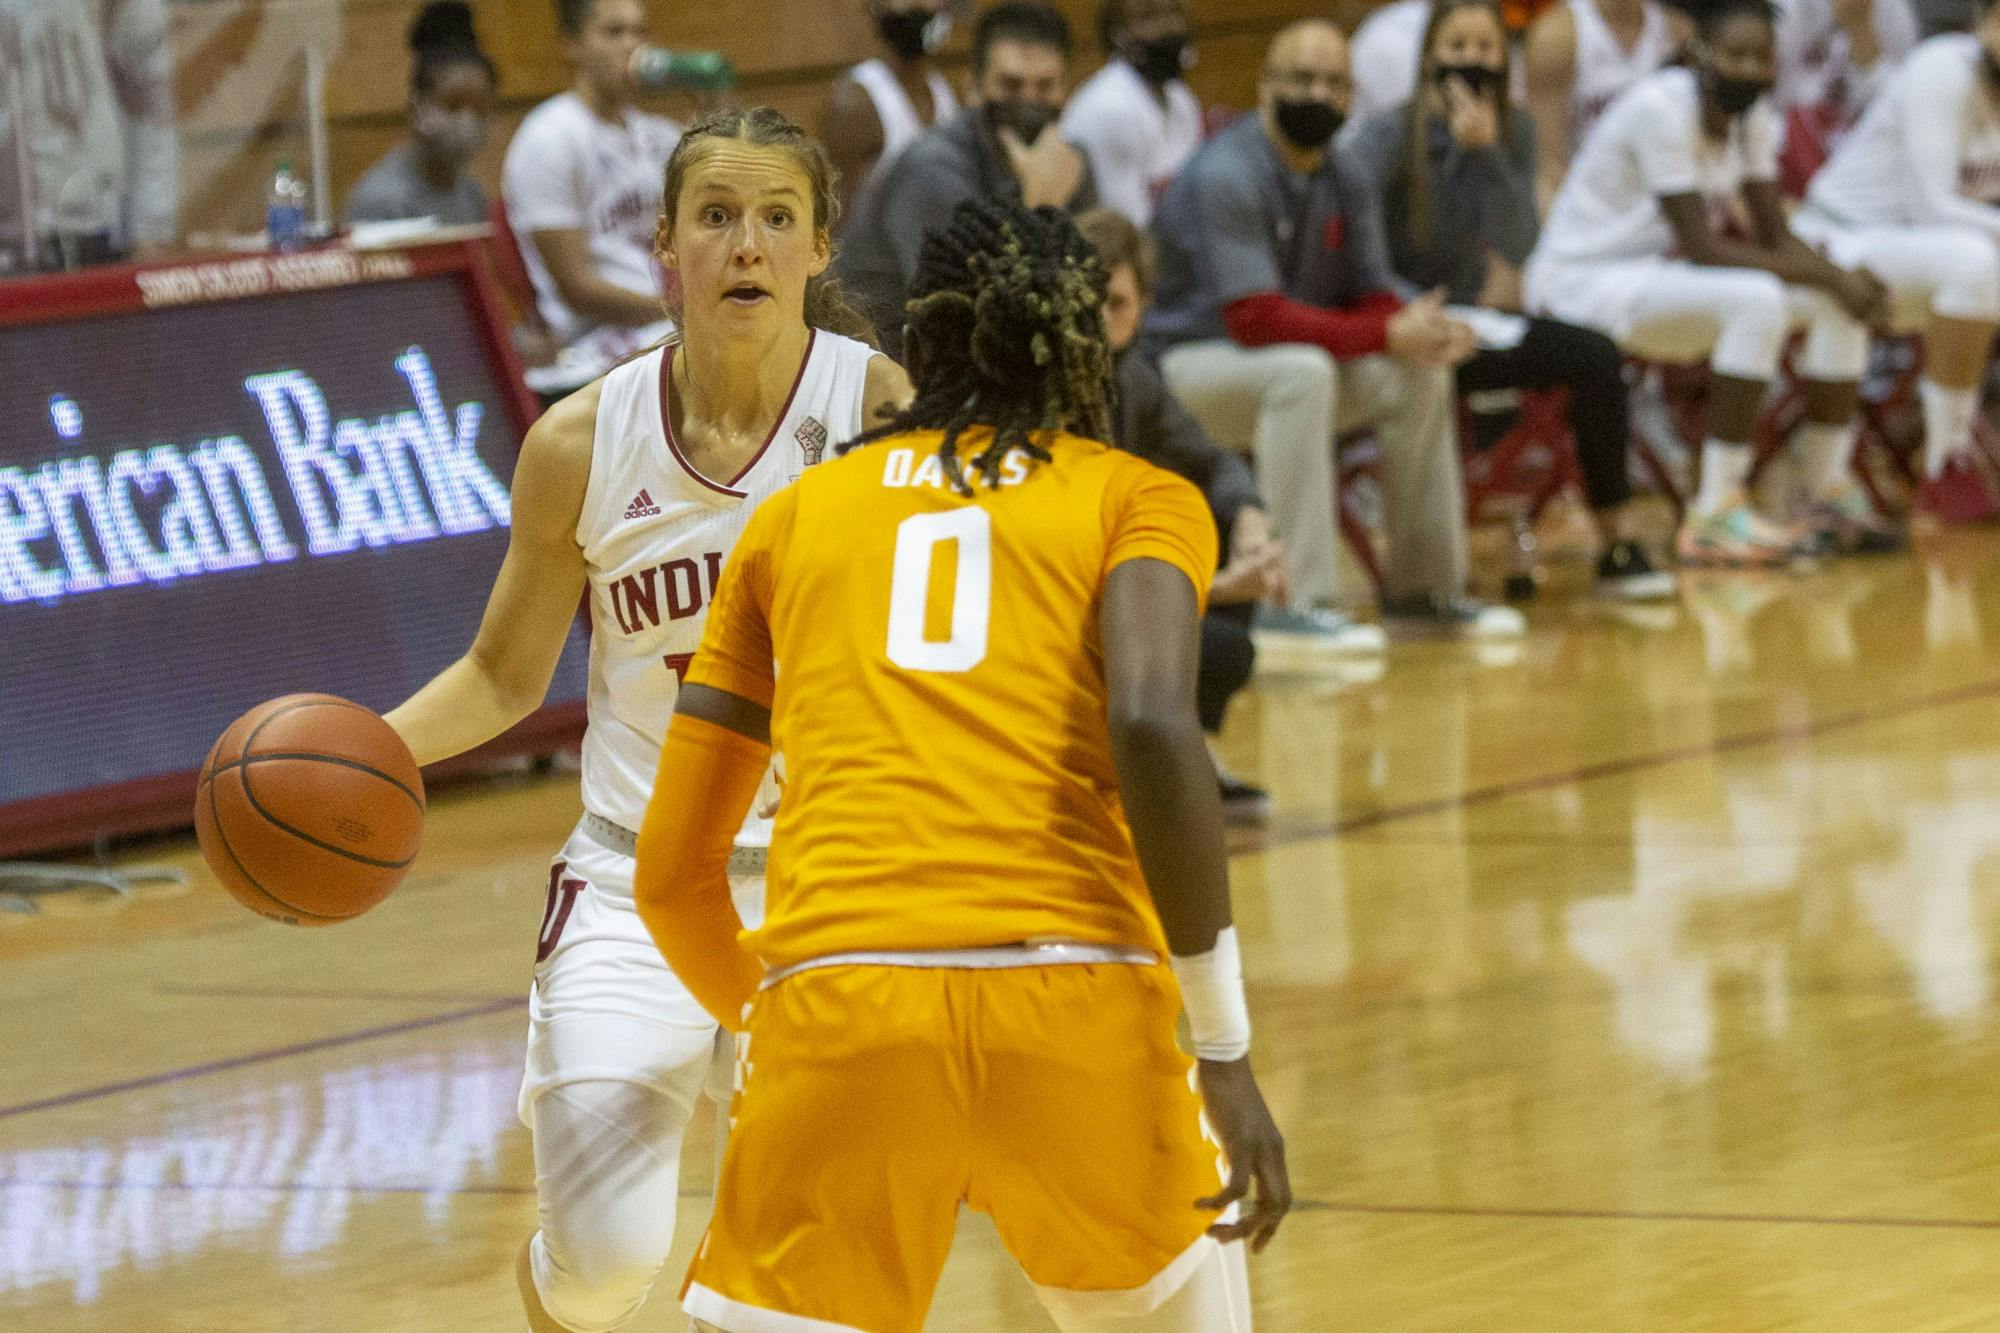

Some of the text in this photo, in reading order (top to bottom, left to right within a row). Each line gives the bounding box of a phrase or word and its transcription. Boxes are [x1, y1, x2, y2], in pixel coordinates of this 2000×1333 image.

[0, 344, 511, 605] erican Bank
[623, 505, 662, 521] adidas
[887, 505, 991, 672] 0
